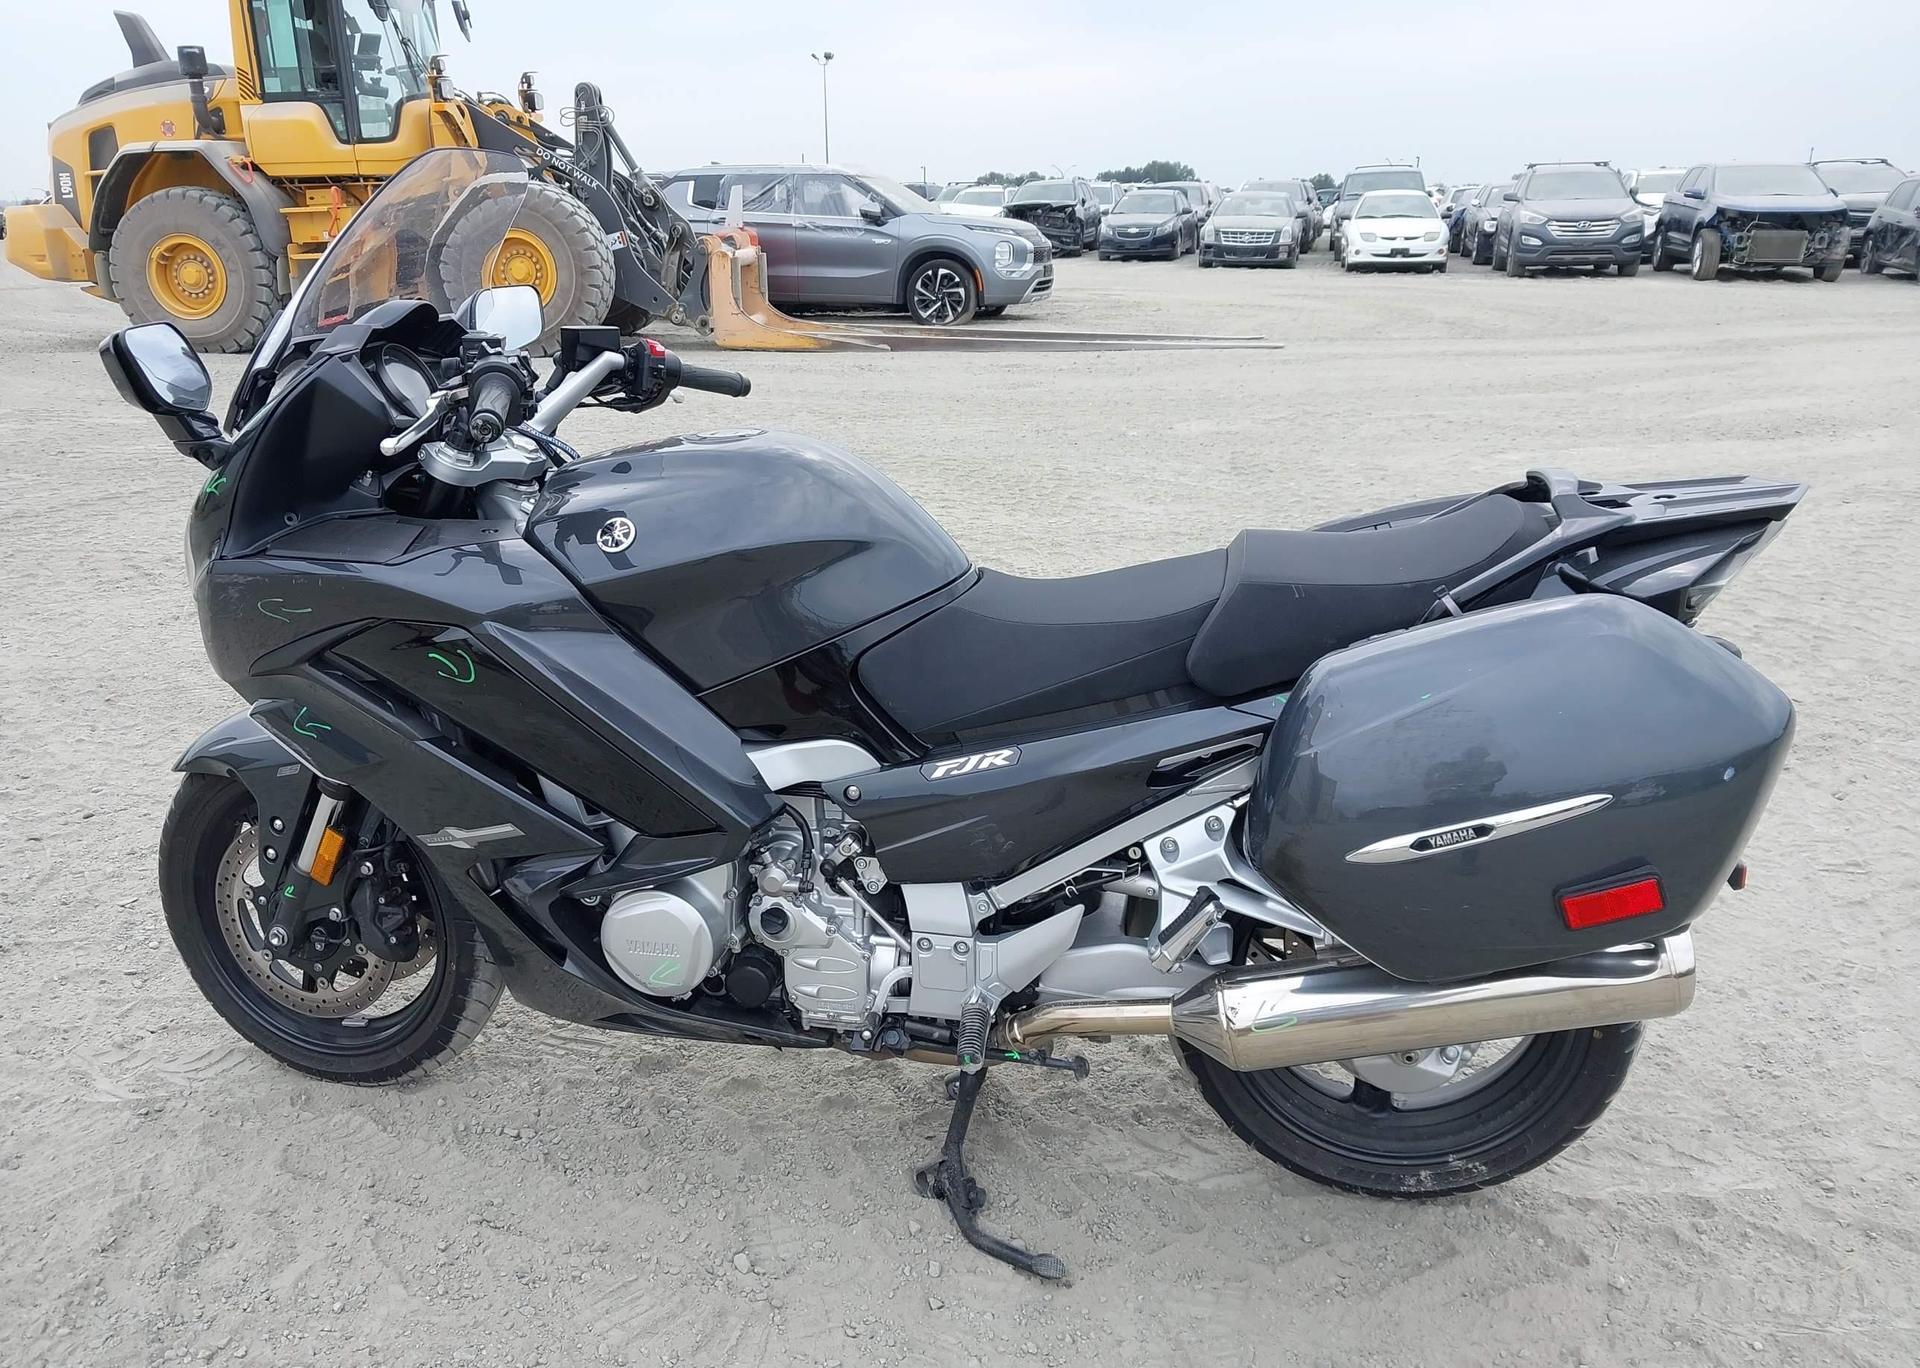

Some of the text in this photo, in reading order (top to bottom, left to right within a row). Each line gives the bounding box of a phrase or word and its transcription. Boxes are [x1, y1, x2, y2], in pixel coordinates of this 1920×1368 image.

[535, 147, 599, 191] DO NOT WALK
[58, 172, 74, 199] L90H
[929, 749, 1015, 779] FJR
[1427, 827, 1477, 848] YAMAHA
[625, 939, 681, 957] YAMAHA
